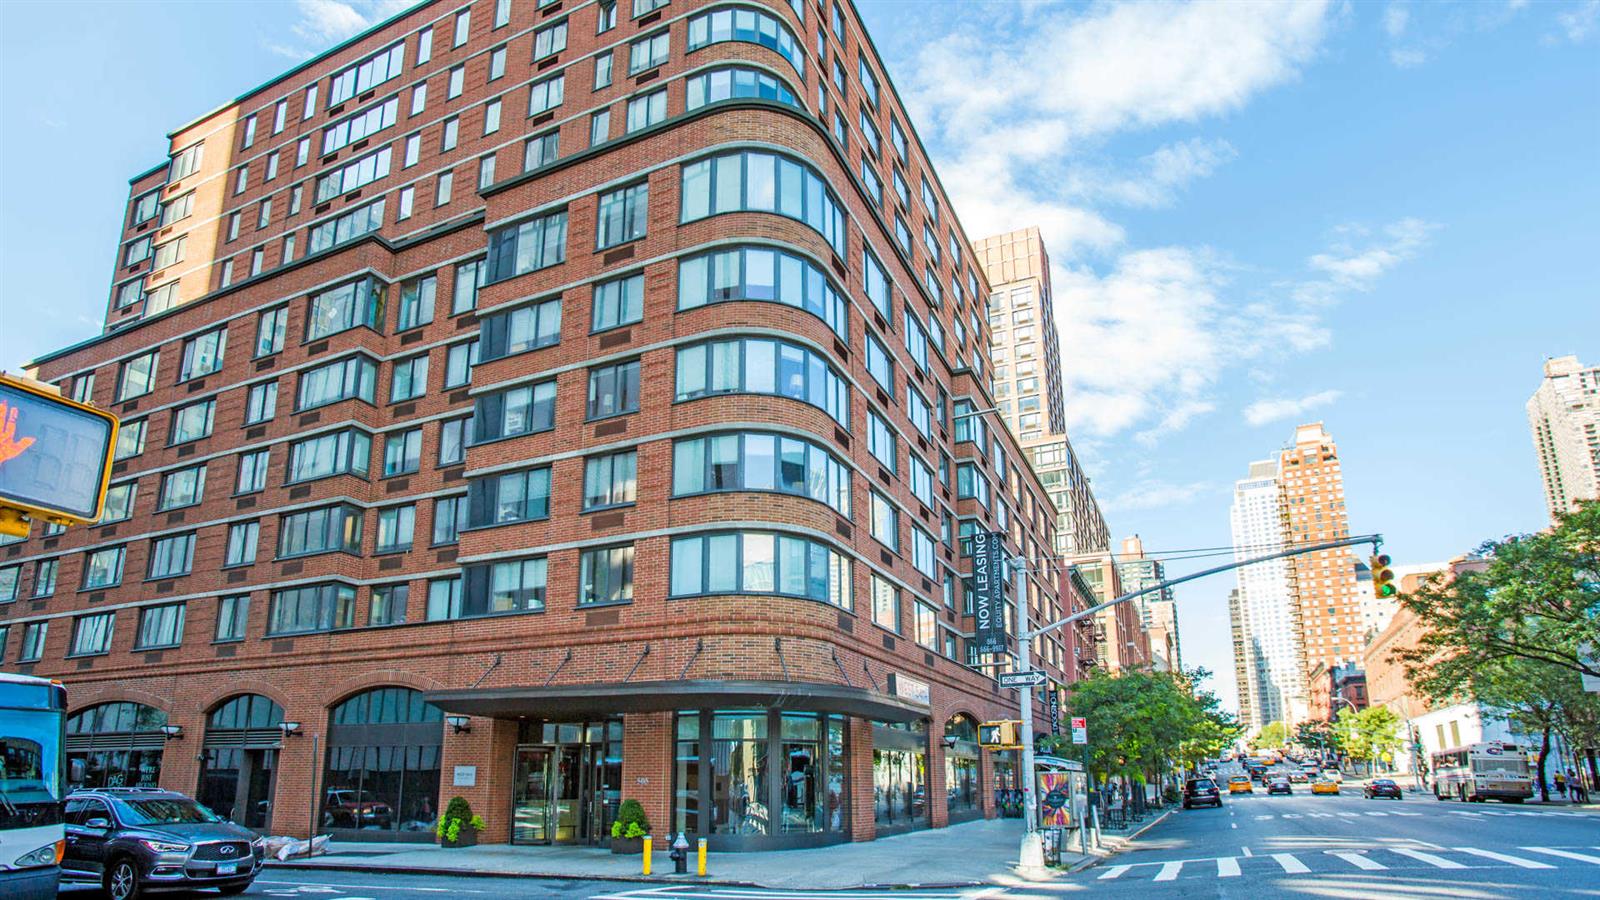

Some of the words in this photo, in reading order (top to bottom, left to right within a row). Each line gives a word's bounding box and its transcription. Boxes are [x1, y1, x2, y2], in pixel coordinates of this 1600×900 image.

[975, 534, 989, 592] LEASING
[978, 595, 990, 630] NOW
[1025, 674, 1040, 682] WAY
